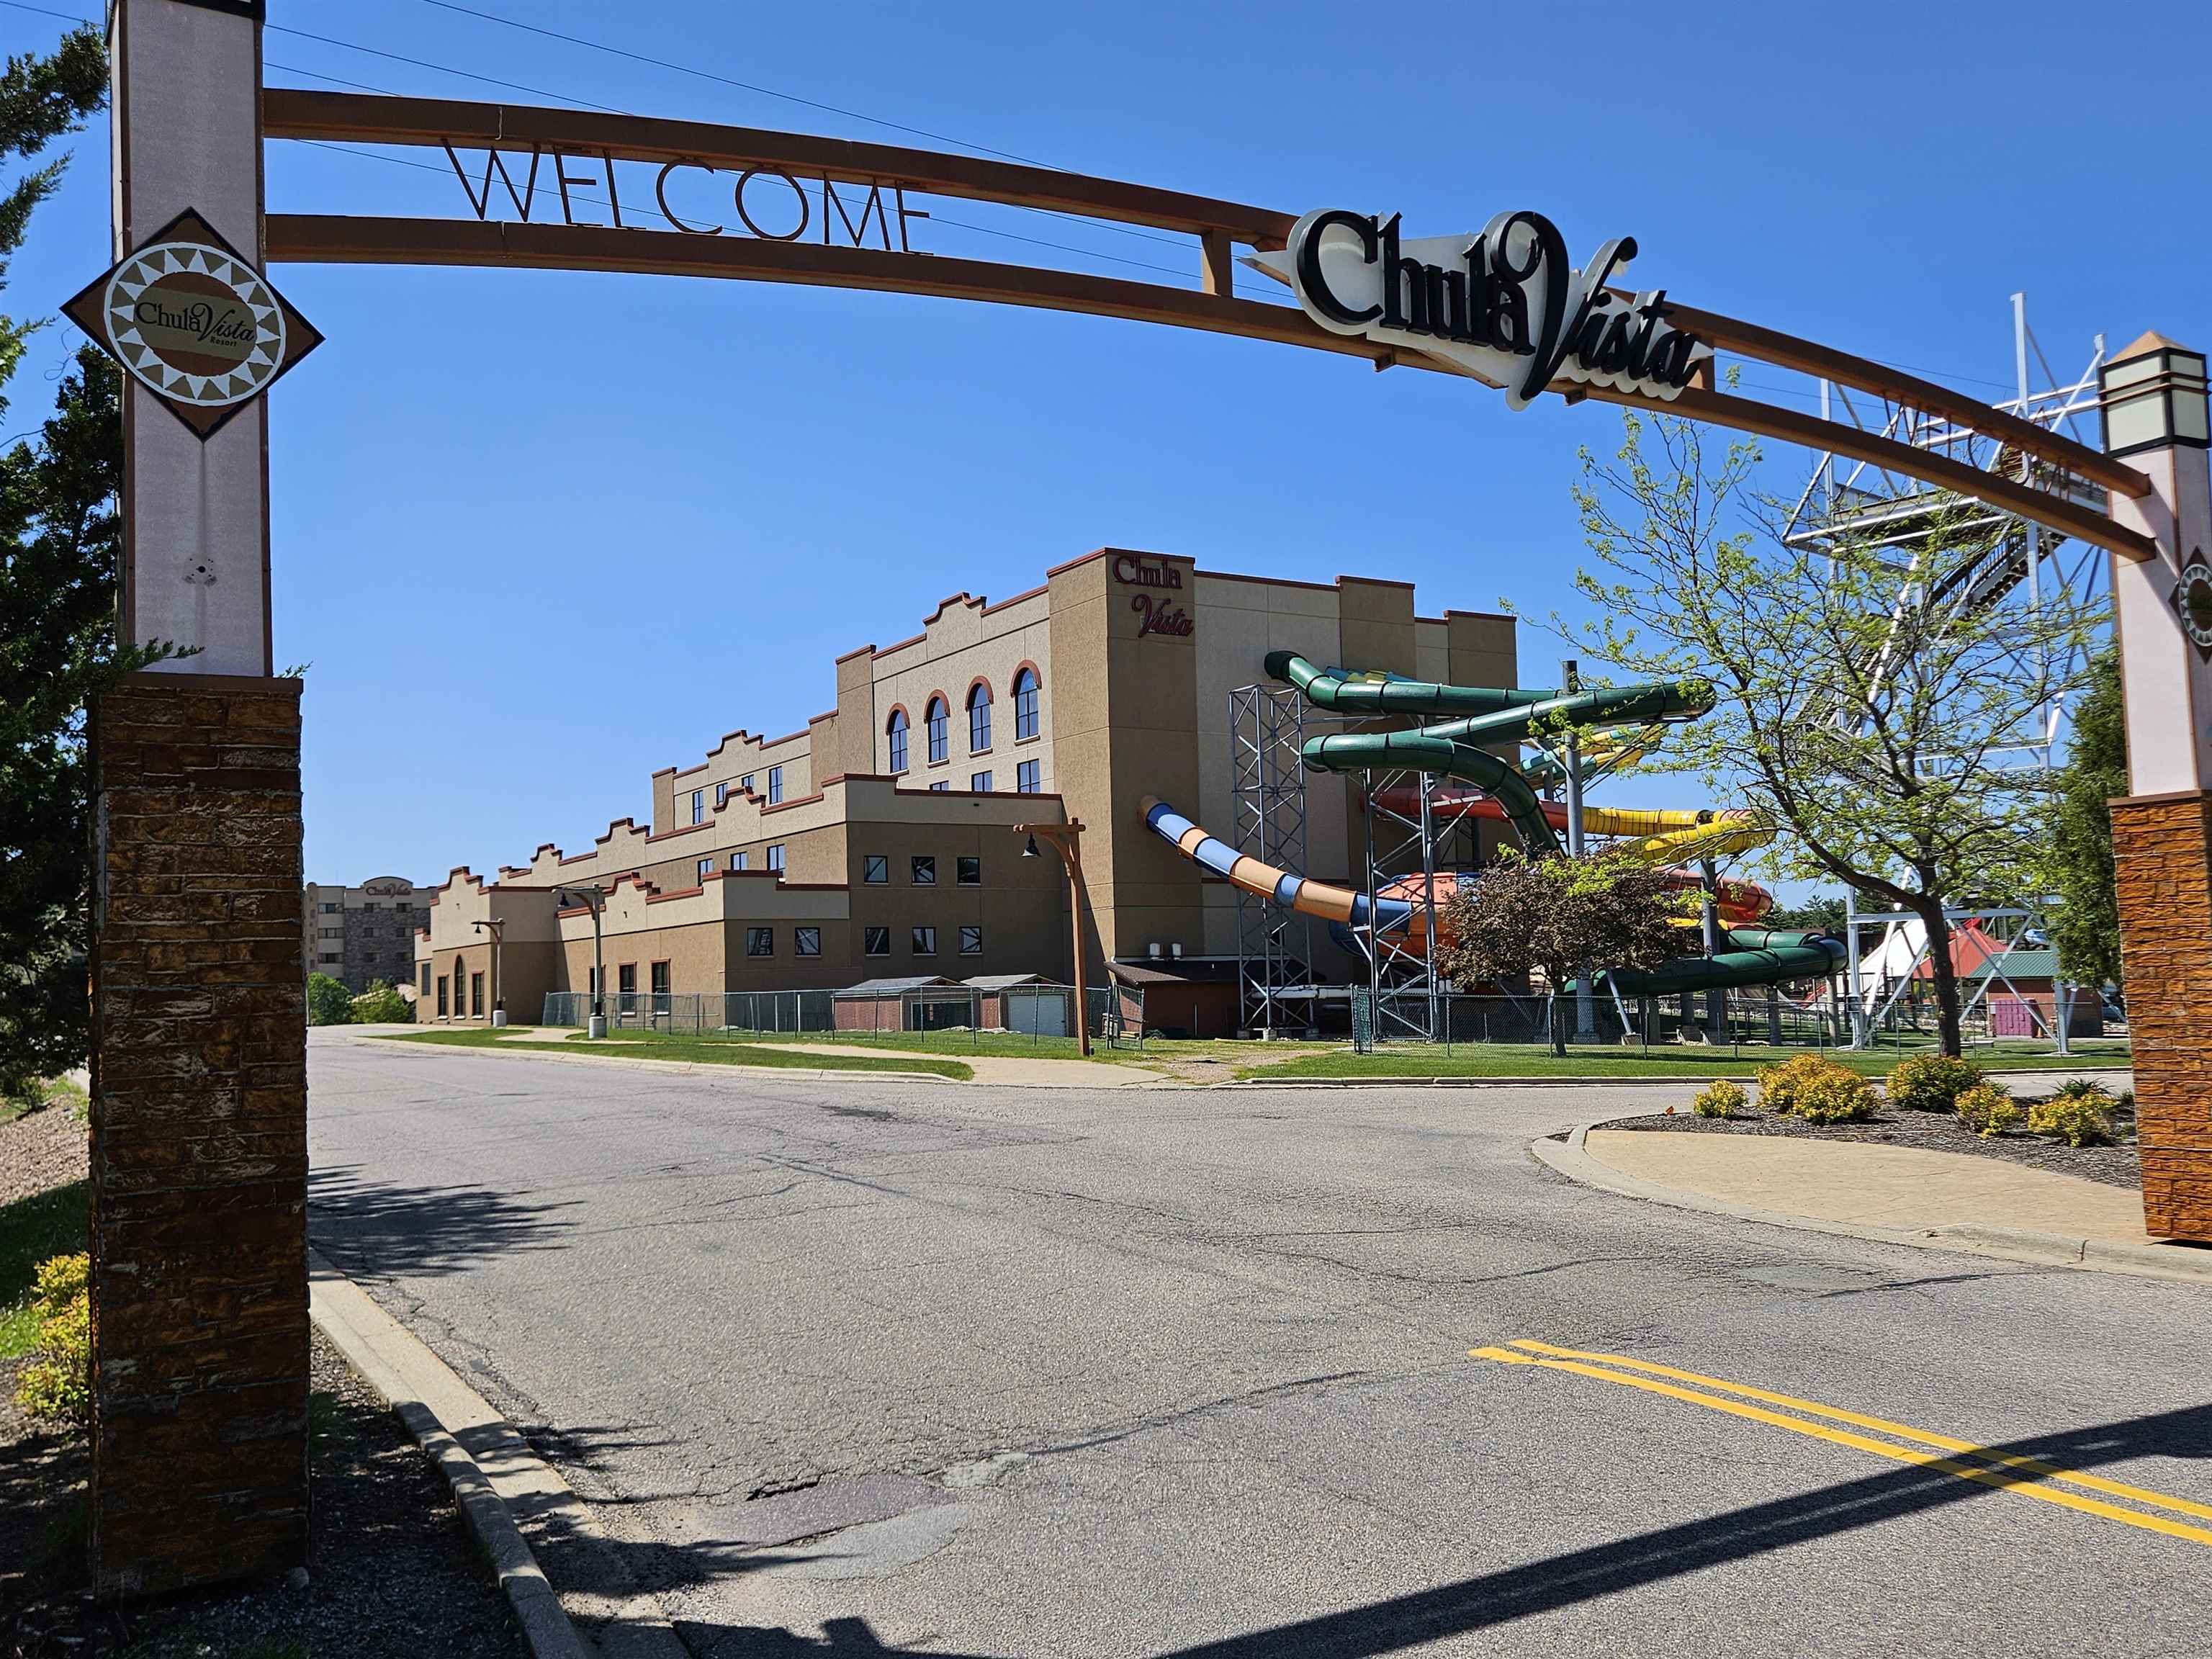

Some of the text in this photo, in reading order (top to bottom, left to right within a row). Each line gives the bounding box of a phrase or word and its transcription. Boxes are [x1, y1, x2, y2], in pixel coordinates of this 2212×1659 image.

[441, 138, 934, 256] WELCOME
[136, 302, 255, 341] Chula Vista
[1296, 210, 1700, 401] Chula Vista
[210, 336, 237, 346] Resort
[1112, 555, 1183, 589] Chula
[1131, 593, 1194, 638] Vista
